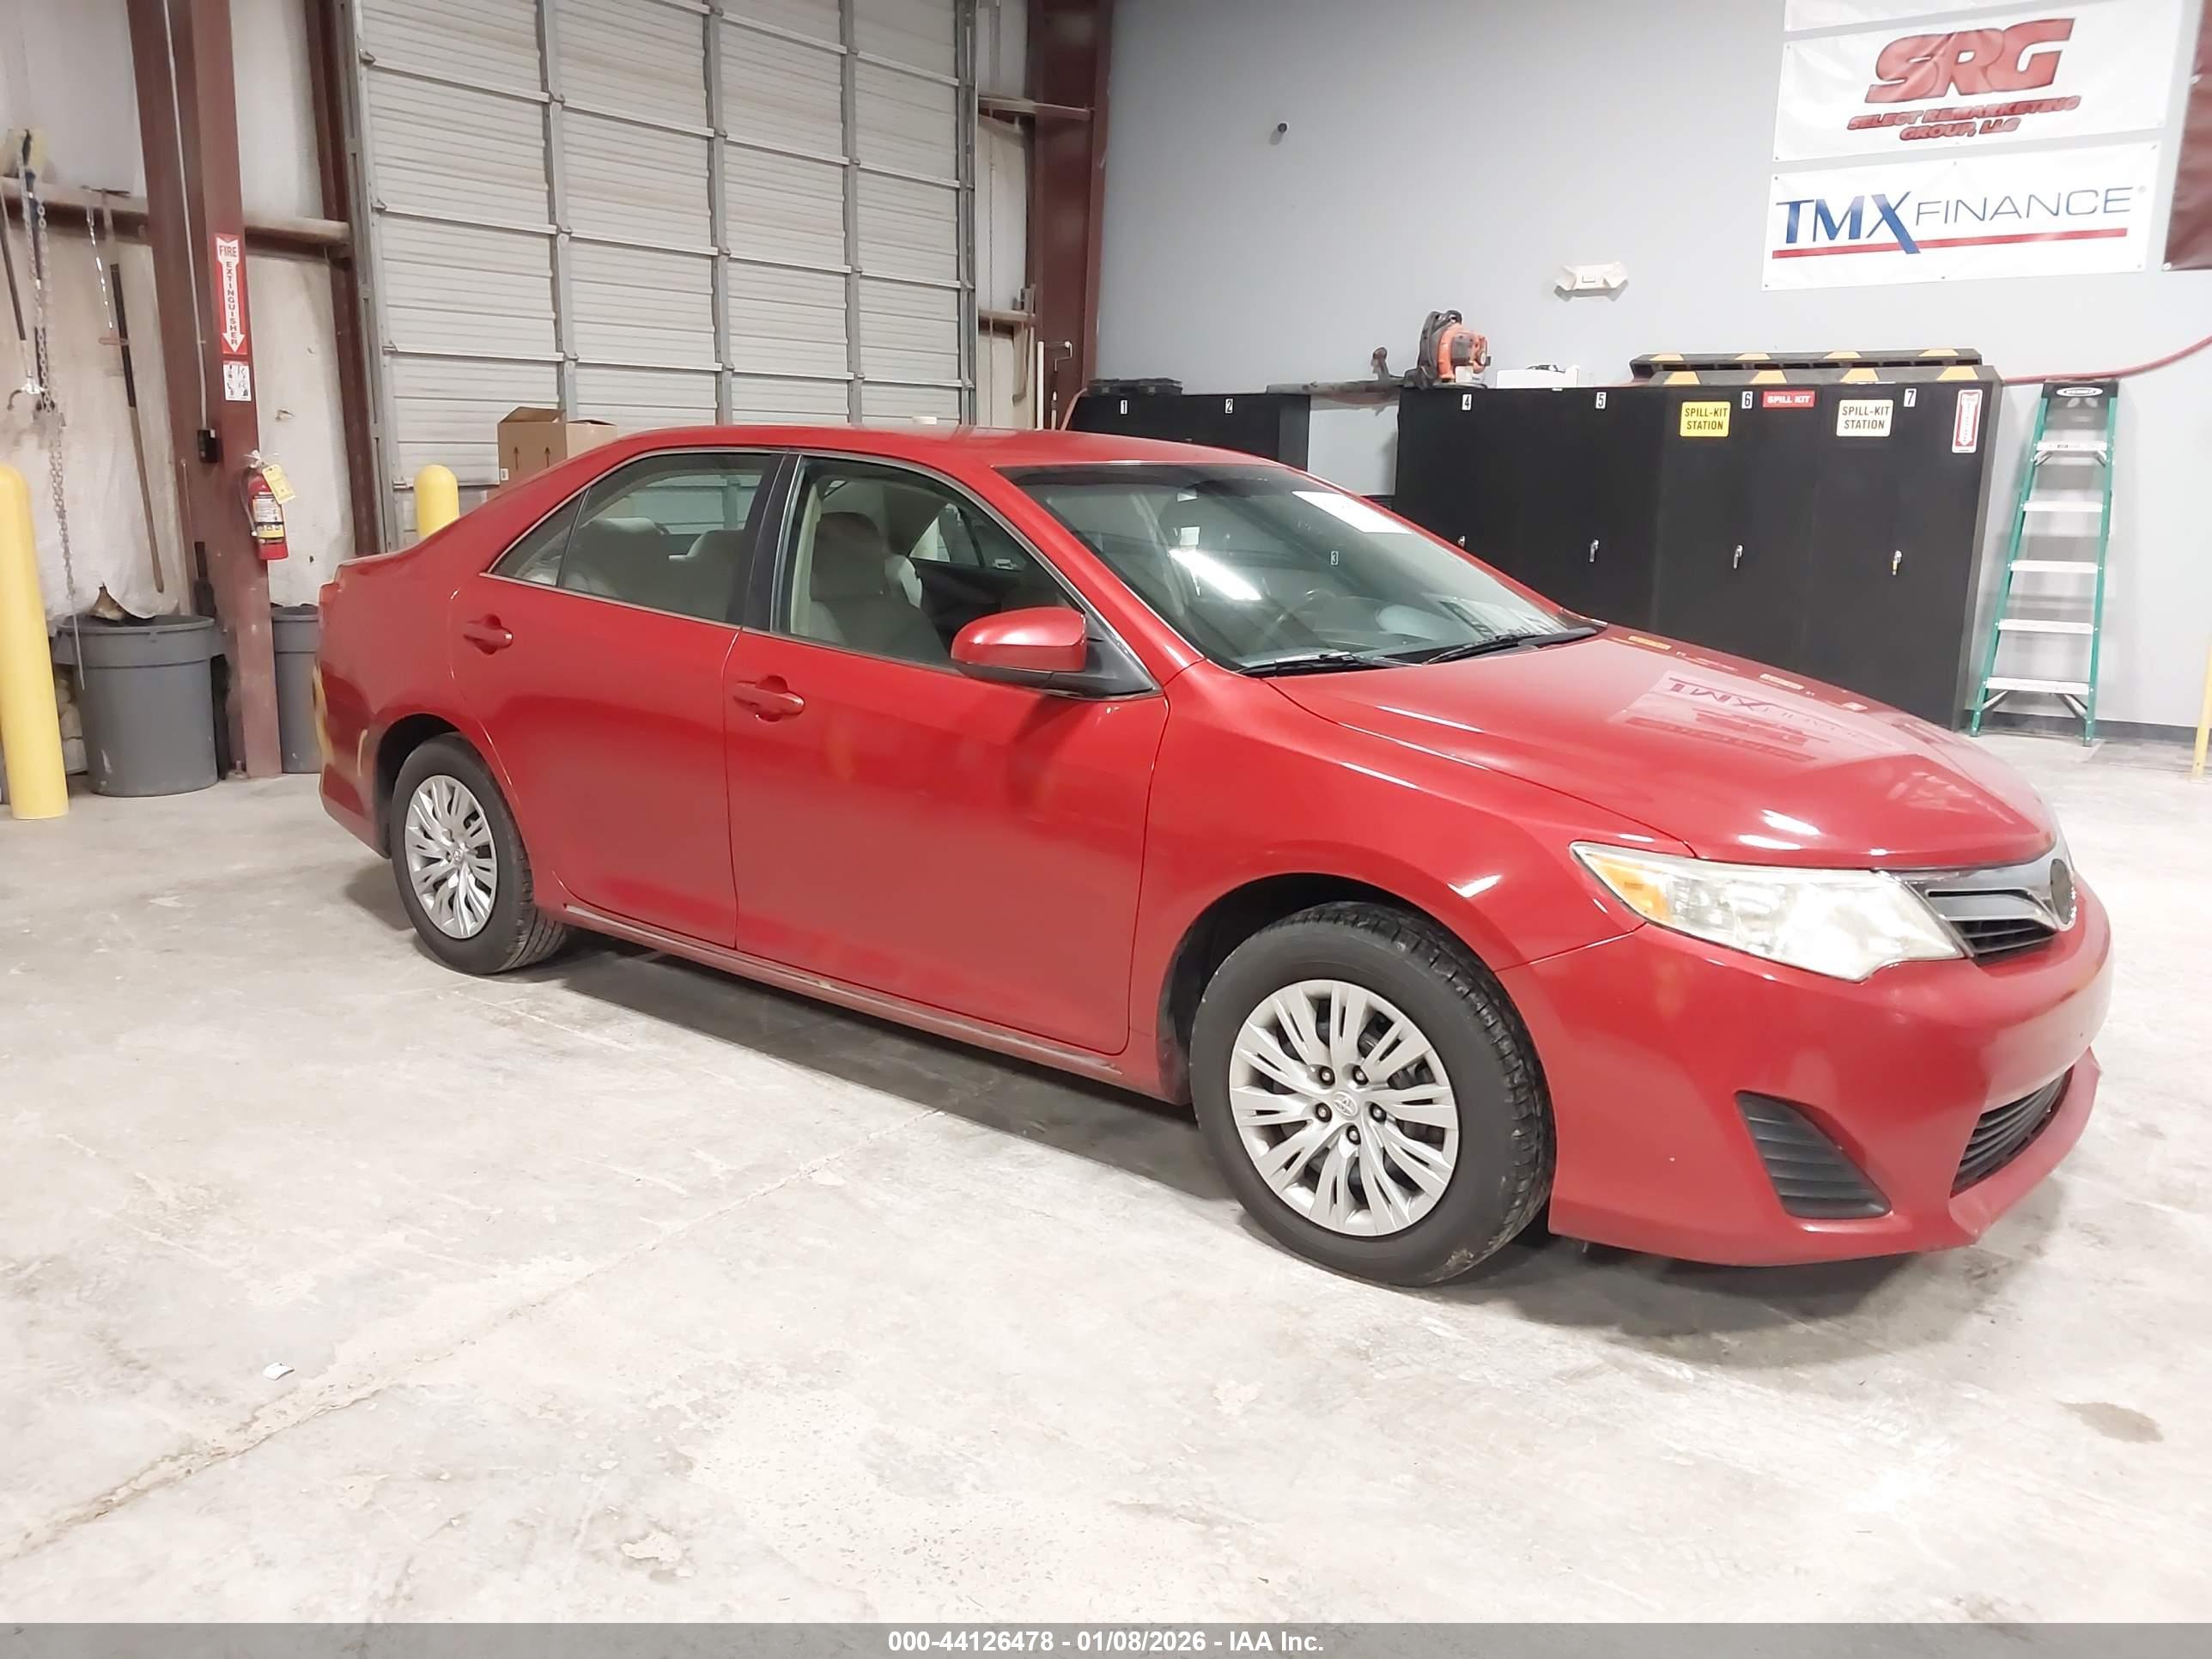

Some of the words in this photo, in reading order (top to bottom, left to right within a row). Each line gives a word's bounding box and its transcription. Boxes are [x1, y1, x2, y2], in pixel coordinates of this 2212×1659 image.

[1864, 18, 2075, 103] SRG
[1847, 110, 1923, 131] SELECT
[1922, 95, 2081, 123] REMARKETING
[1899, 121, 1977, 141] GROUP,
[1979, 118, 2021, 134] LLC
[1776, 191, 1920, 254] TMX
[1916, 187, 2134, 226] FINANCE
[219, 246, 237, 258] FIRE
[226, 261, 238, 345] EXTINGUISHER
[1766, 395, 1793, 404] SPILL
[1794, 395, 1812, 404] KIT
[1684, 407, 1729, 418] SPILL-KIT
[1841, 405, 1891, 416] SPILL-KIT
[1686, 420, 1724, 431] STATION
[1844, 419, 1886, 430] STATION
